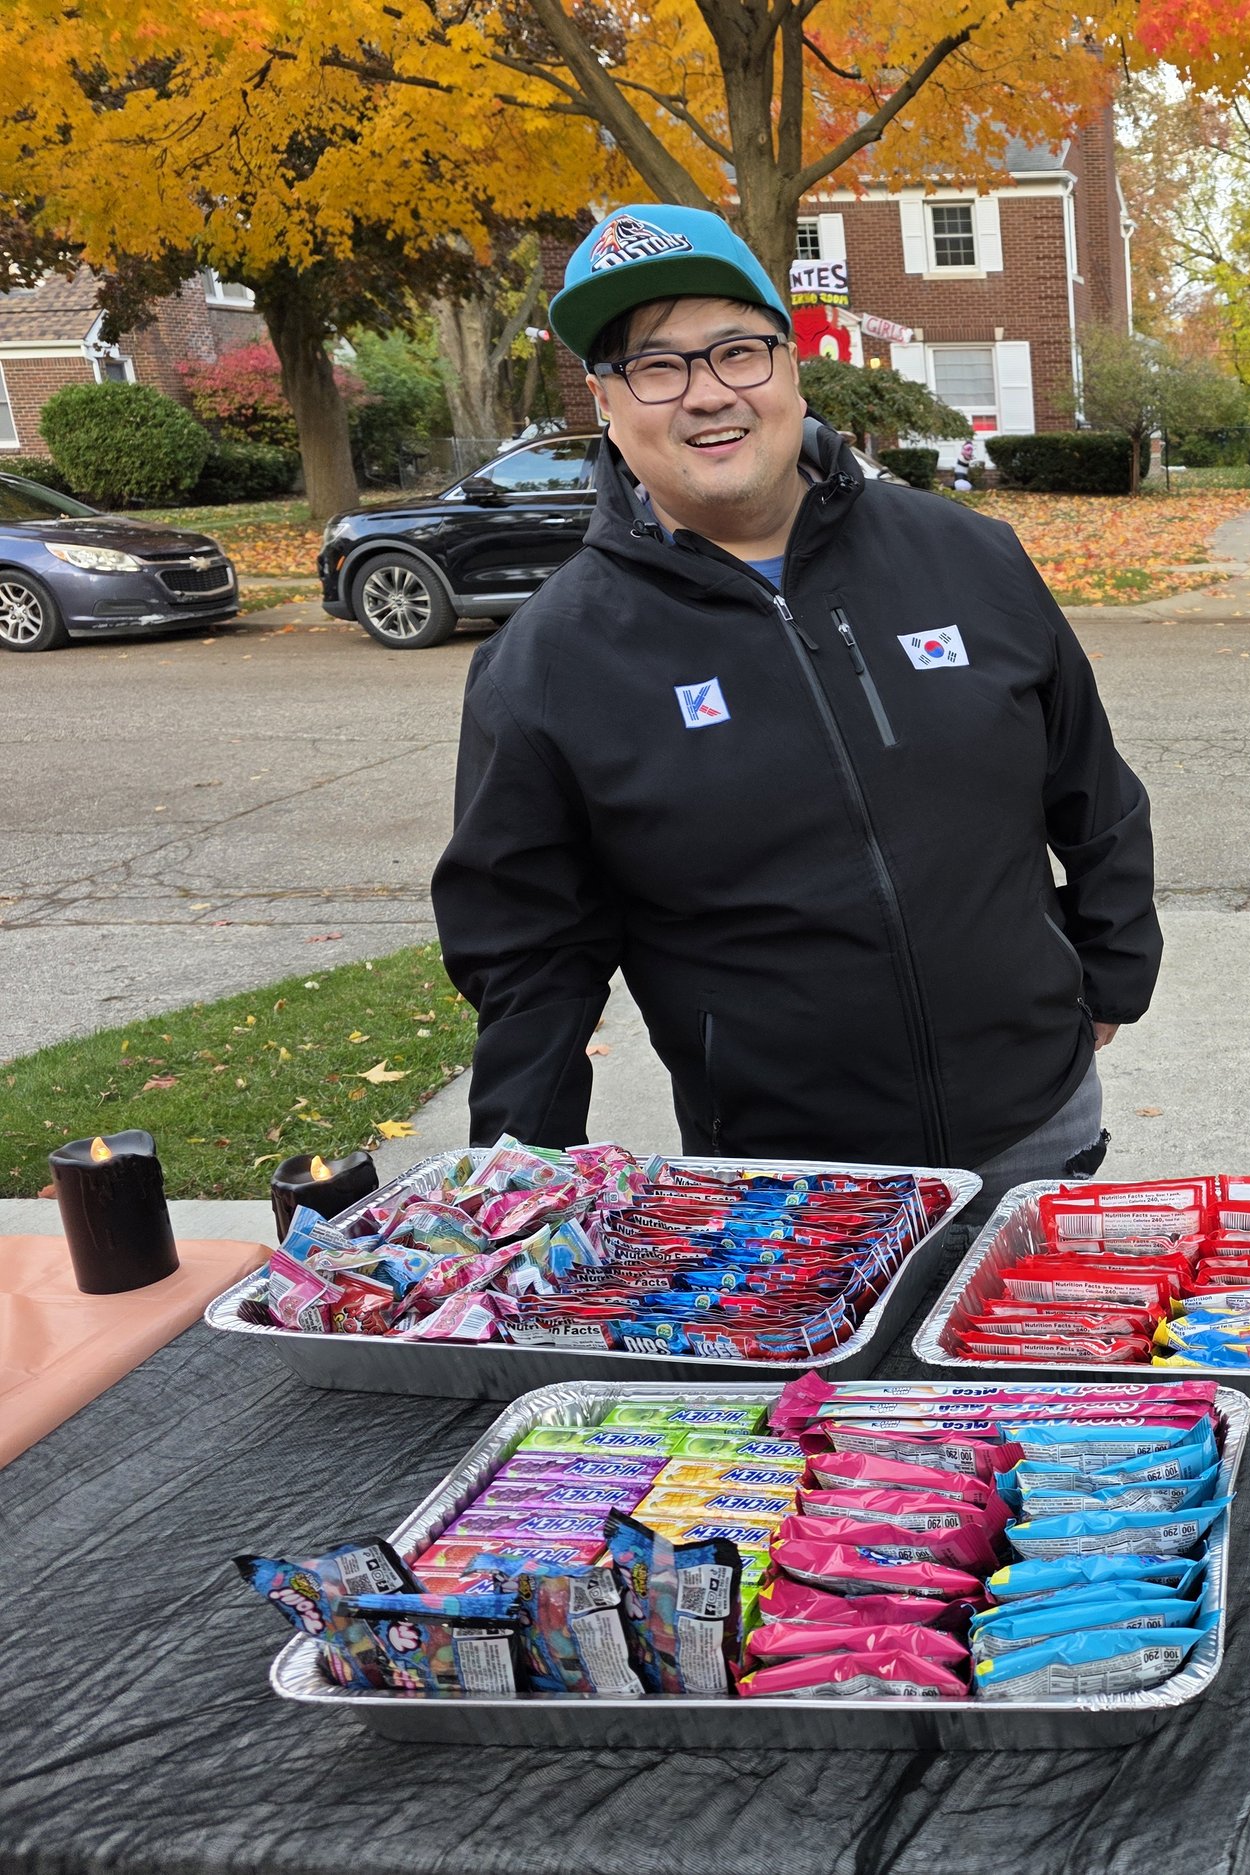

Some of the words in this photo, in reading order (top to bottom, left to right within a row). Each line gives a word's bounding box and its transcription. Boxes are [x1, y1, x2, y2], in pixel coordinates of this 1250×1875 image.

[563, 1325, 600, 1335] Facts
[952, 1387, 998, 1395] MEGA
[668, 1410, 747, 1422] HI-CHEW
[942, 1421, 989, 1430] MEGA
[585, 1432, 665, 1447] HI-CHEW
[946, 1450, 959, 1460] 290
[960, 1450, 973, 1461] 100
[564, 1461, 646, 1476] HI-CHEW
[1164, 1467, 1178, 1477] 100
[721, 1469, 800, 1485] HI-CHEW
[1147, 1472, 1162, 1481] 290
[545, 1488, 629, 1504] HI-CHEW
[705, 1496, 790, 1512] HI-CHEW
[517, 1517, 604, 1533] HI-CHEW
[927, 1519, 940, 1529] 290
[944, 1517, 959, 1528] 100
[682, 1524, 771, 1542] HI-CHEW
[1163, 1527, 1178, 1537] 290
[1182, 1525, 1195, 1533] 100
[1143, 1651, 1160, 1663] 290
[1163, 1650, 1179, 1659] 100
